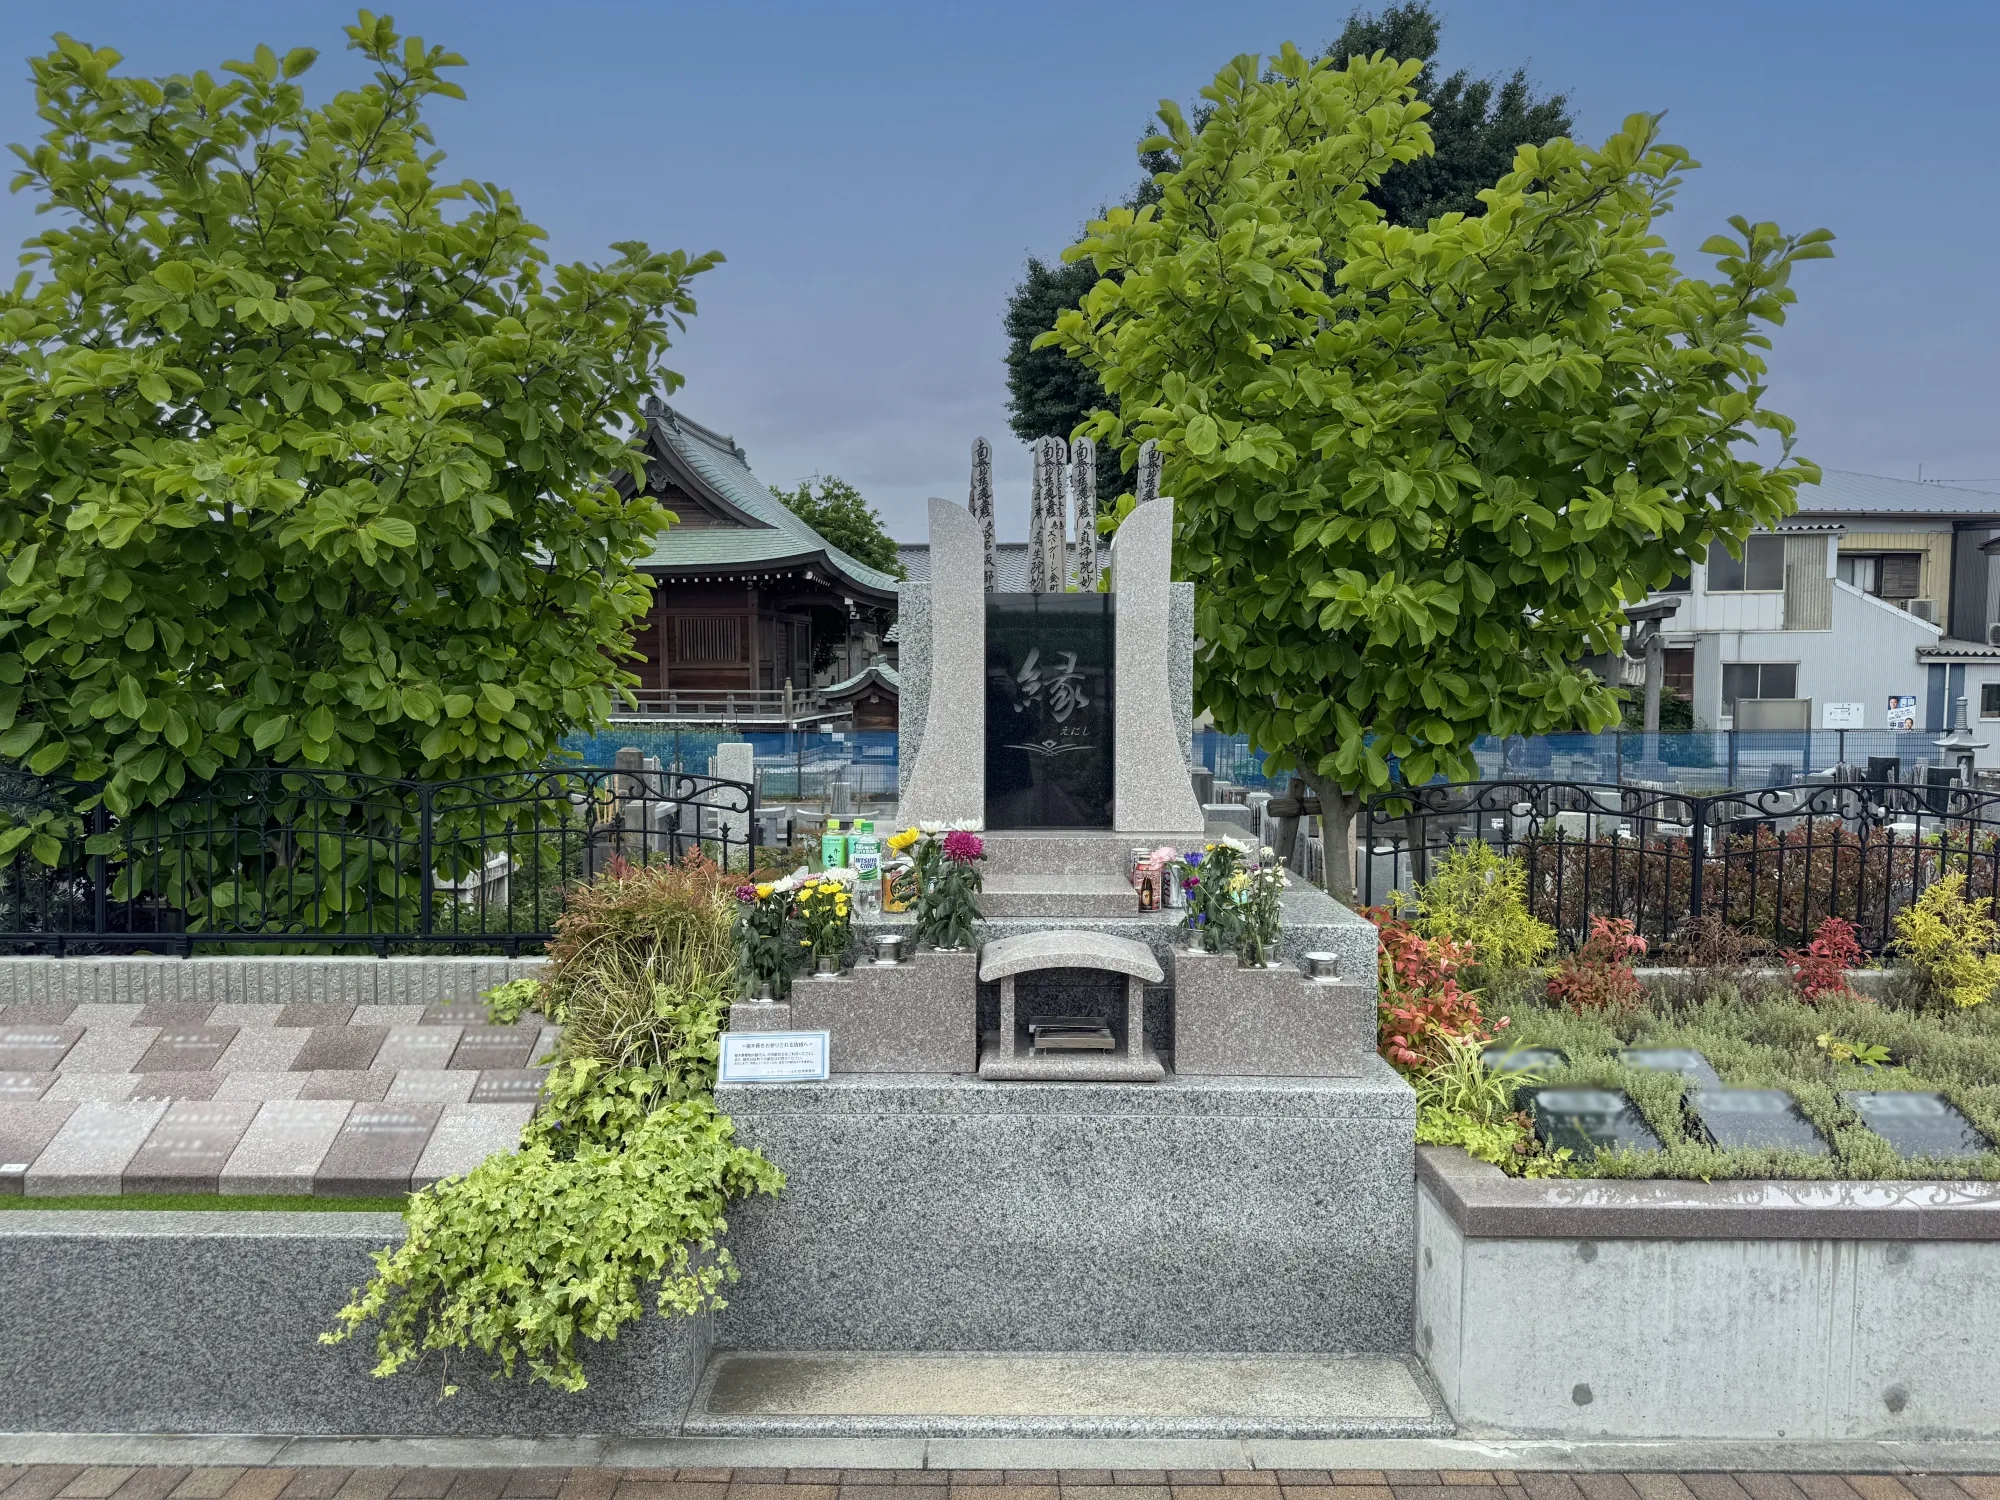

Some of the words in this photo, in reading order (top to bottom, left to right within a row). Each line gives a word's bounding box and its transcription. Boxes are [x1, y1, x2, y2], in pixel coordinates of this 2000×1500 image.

[1013, 647, 1090, 723] 縁
[1059, 726, 1091, 737] えにし
